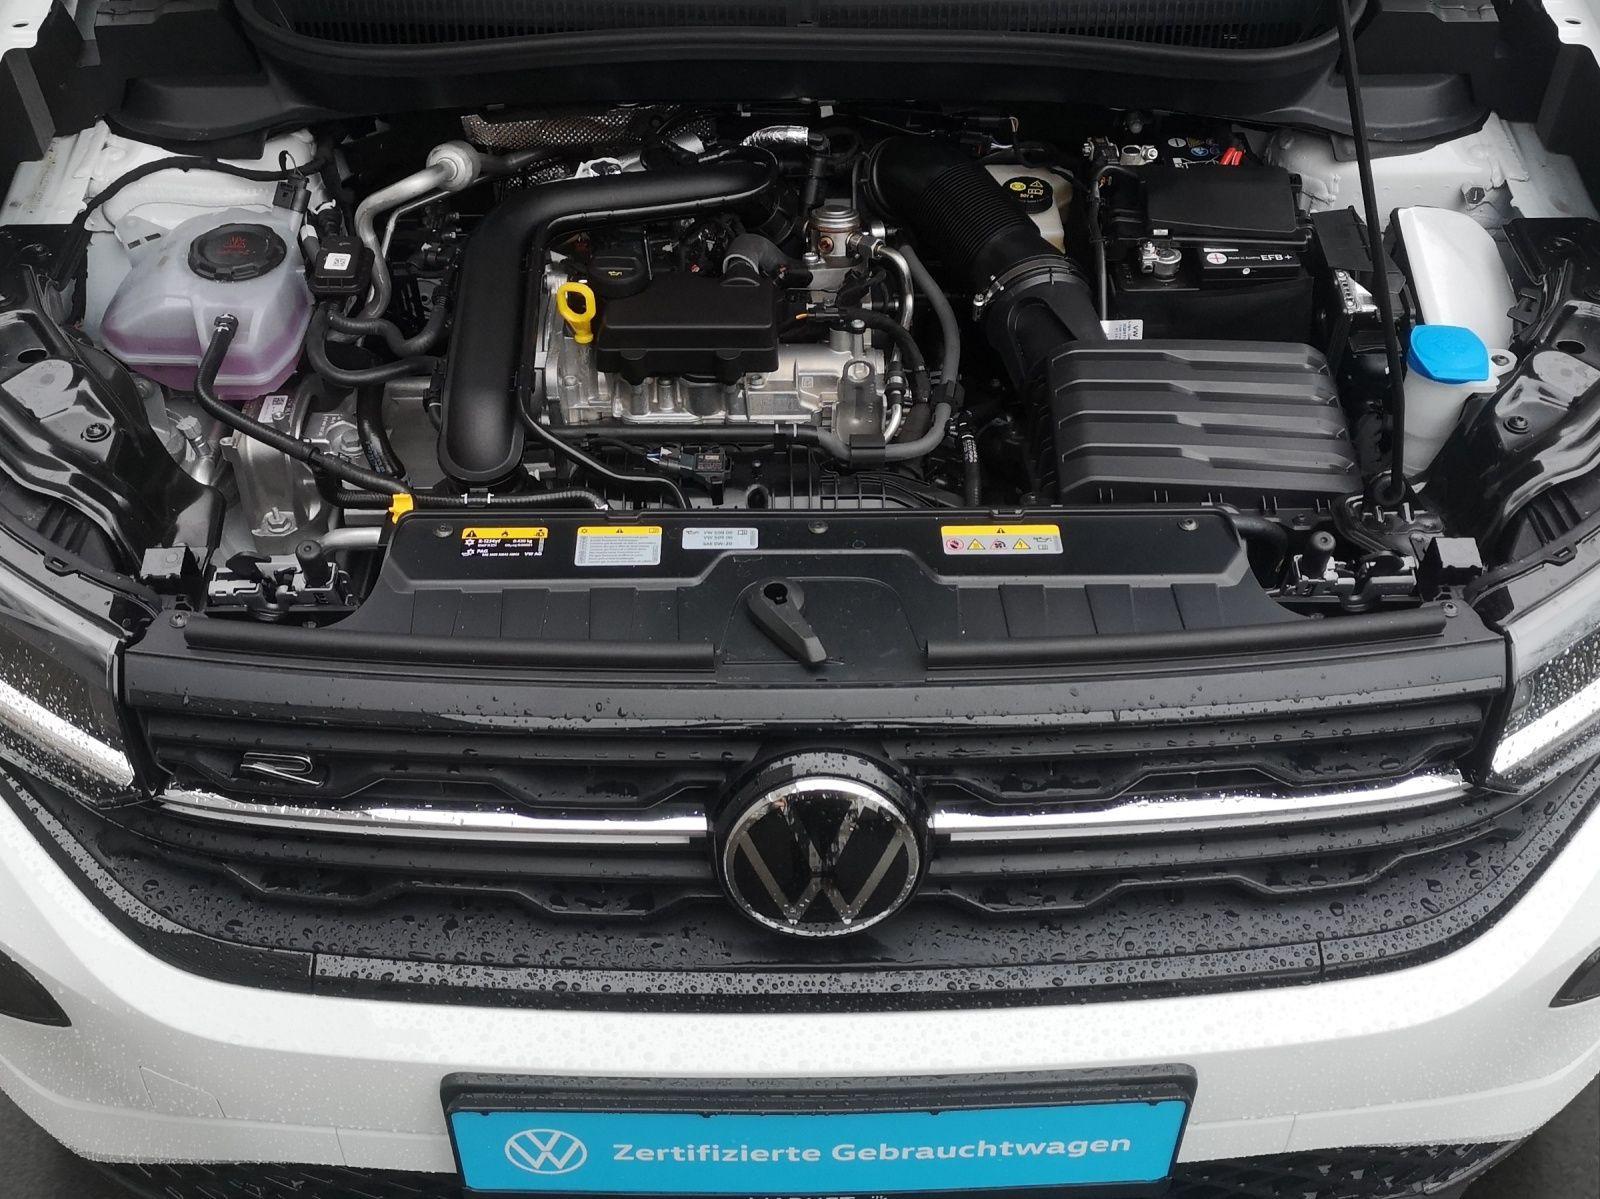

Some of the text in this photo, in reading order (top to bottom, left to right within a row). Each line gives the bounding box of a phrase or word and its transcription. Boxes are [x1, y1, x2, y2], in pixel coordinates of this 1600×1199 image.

[723, 776, 920, 937] VW
[504, 1128, 1132, 1175] VW Zertifizierte Gebrauchtwagen
